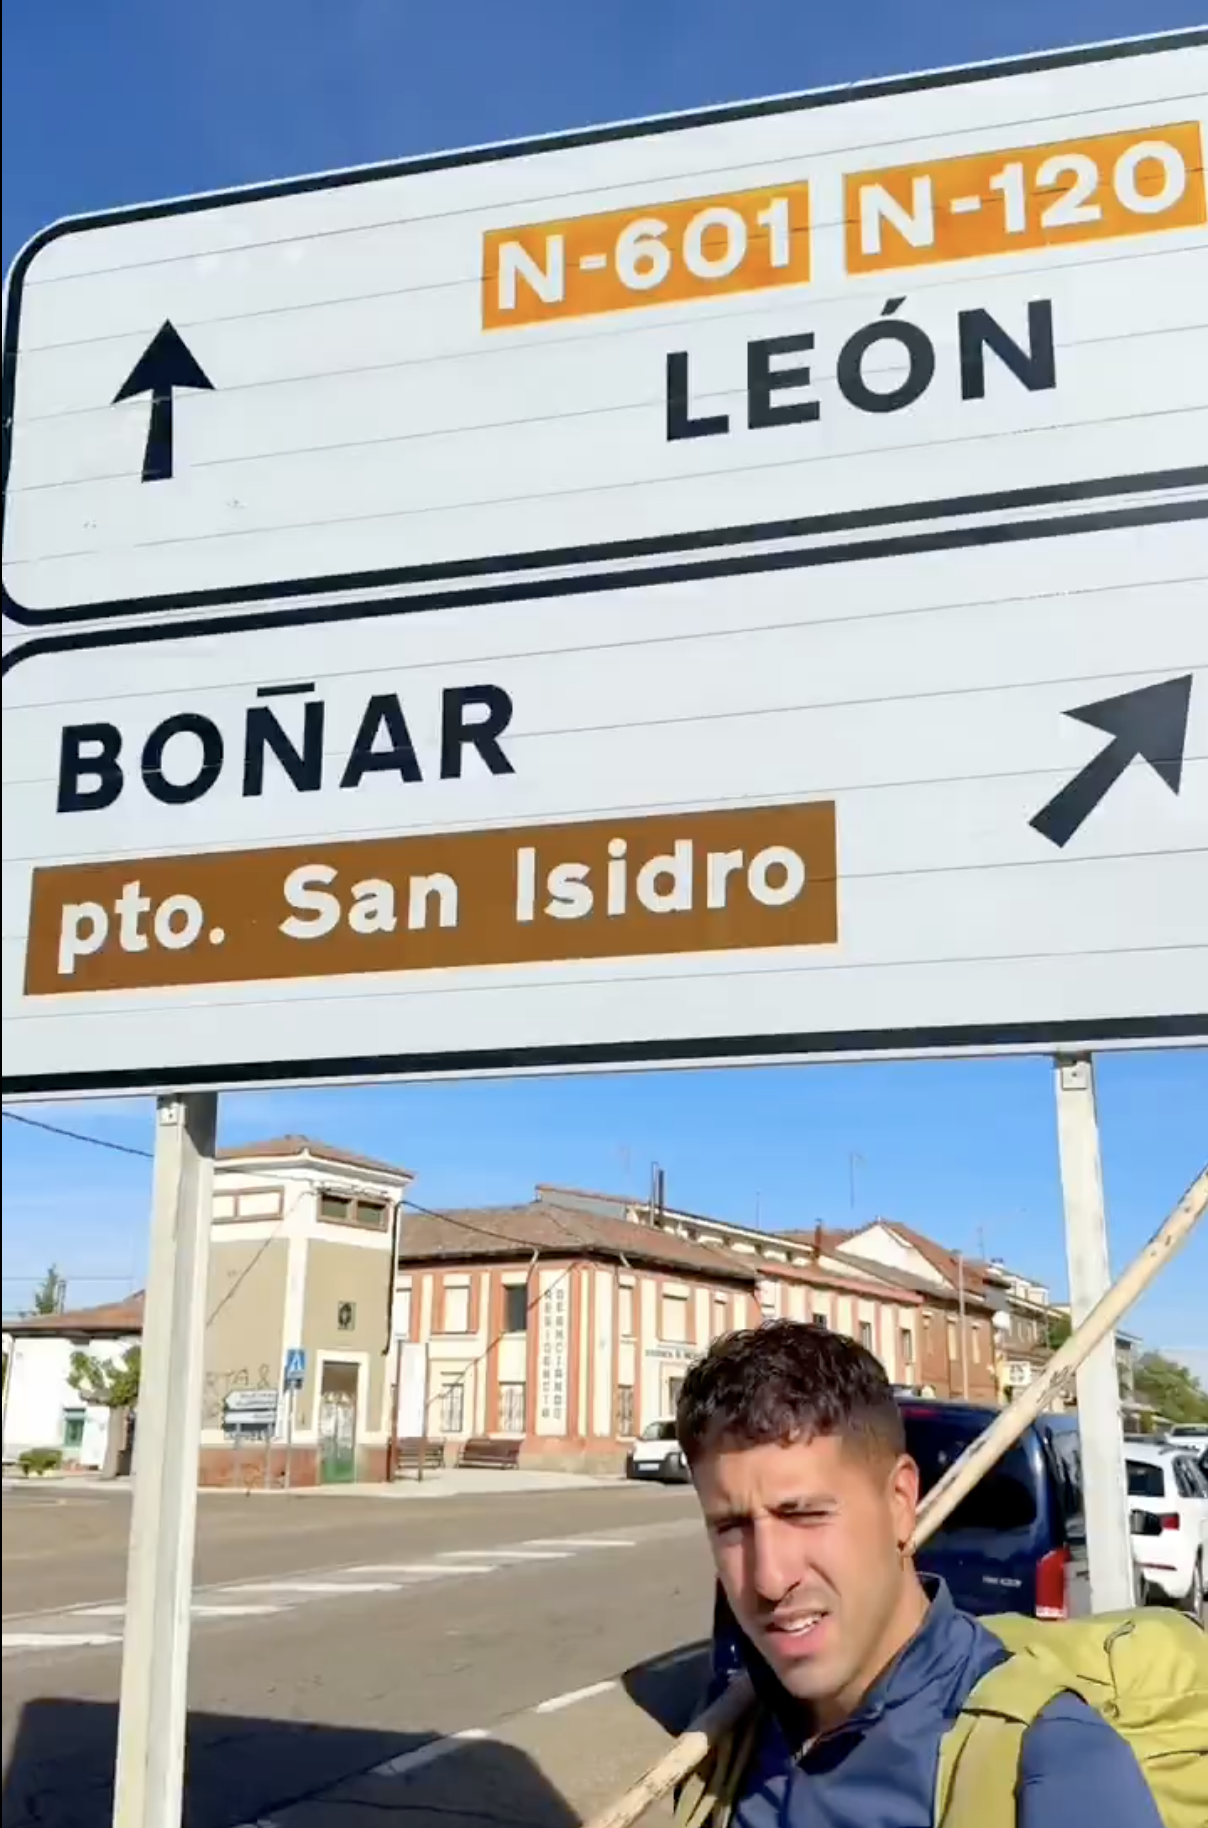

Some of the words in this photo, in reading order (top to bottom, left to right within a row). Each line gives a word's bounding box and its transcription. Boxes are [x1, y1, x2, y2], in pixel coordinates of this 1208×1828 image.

[498, 199, 790, 310] N-601
[859, 141, 1187, 255] N-120
[666, 296, 1057, 442] LEÓN
[56, 682, 516, 814] BOÑAR
[57, 880, 225, 975] pto.
[279, 864, 458, 939] San
[516, 838, 806, 922] Isidro
